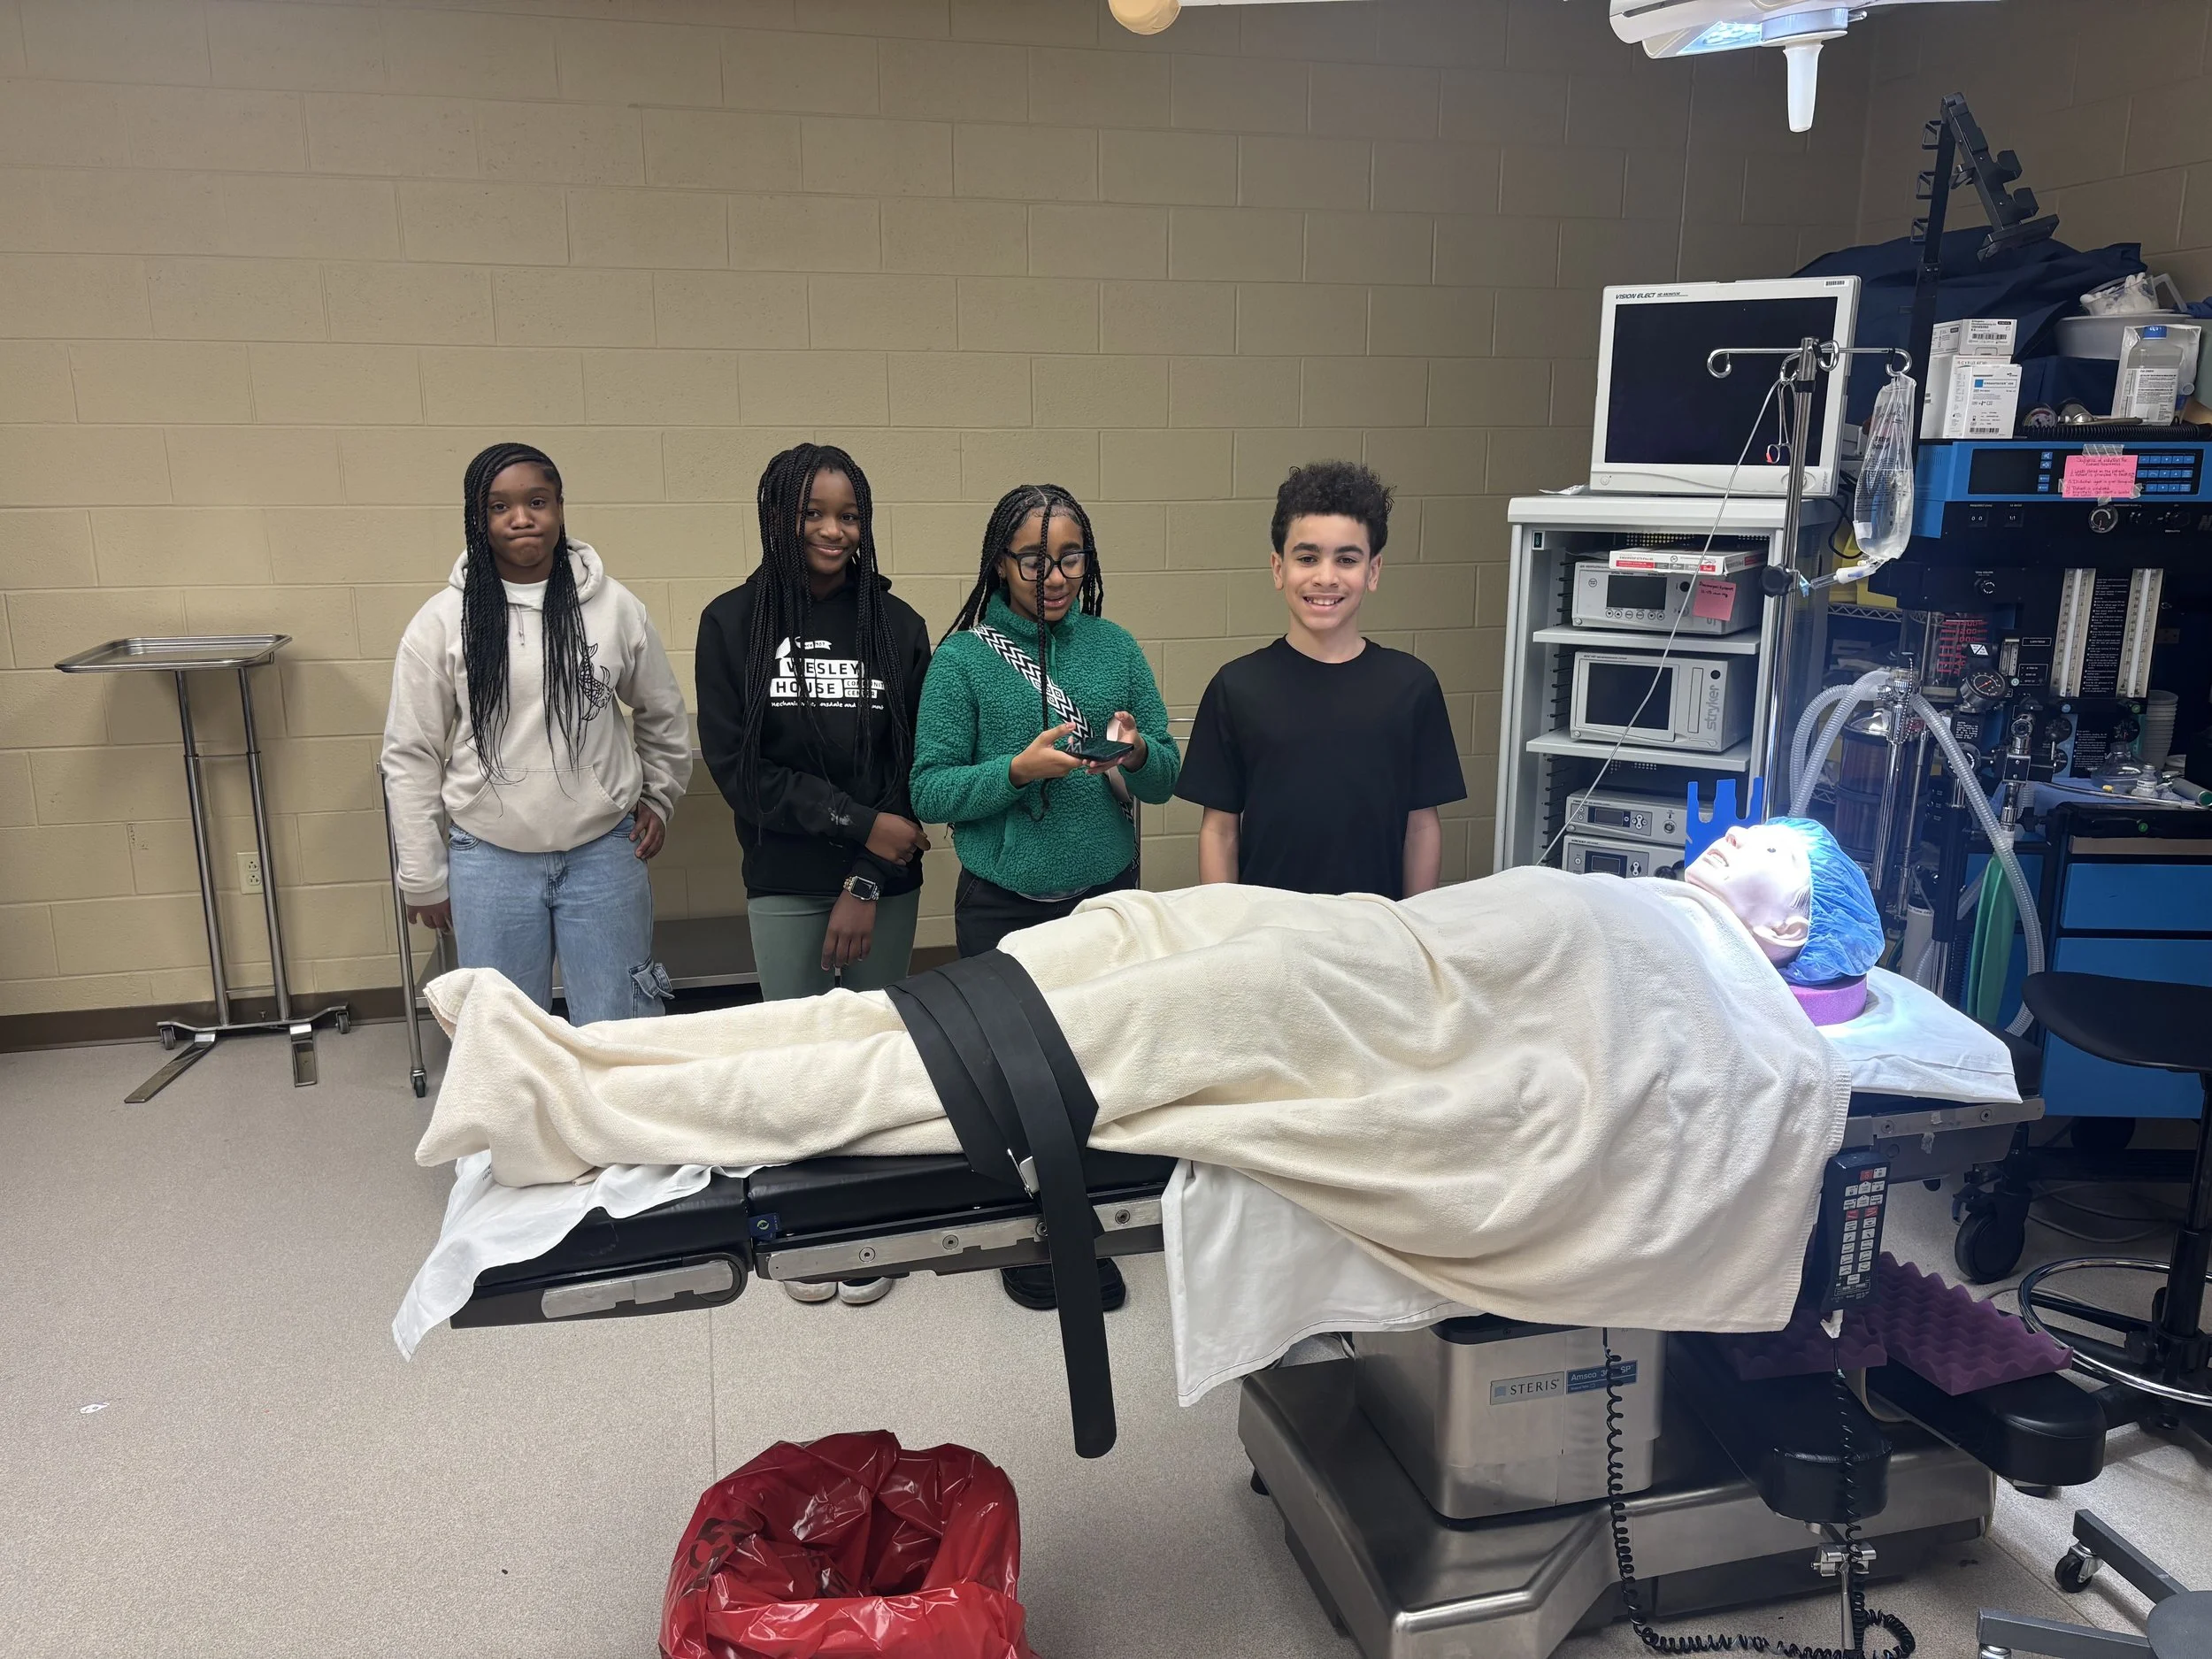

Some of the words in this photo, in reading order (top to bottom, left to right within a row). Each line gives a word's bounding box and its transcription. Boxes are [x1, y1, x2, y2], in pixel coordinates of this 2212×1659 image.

[1707, 685, 1720, 731] stryker
[1571, 1371, 1597, 1381] Amsco
[1510, 1379, 1558, 1395] STERIS
